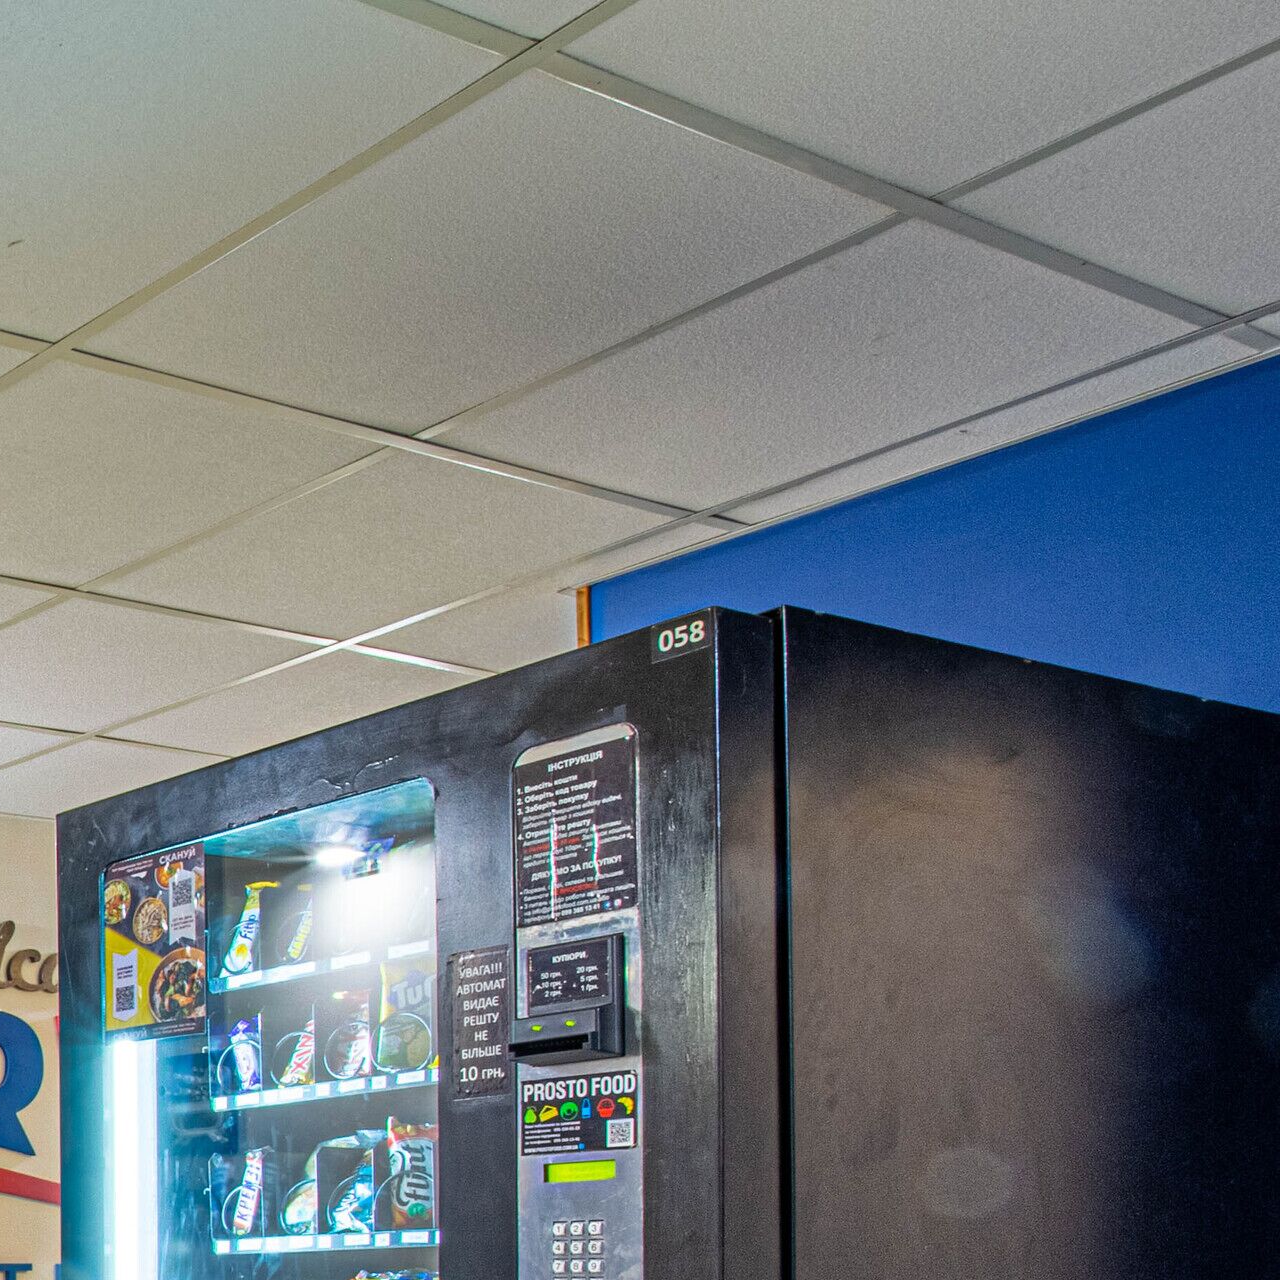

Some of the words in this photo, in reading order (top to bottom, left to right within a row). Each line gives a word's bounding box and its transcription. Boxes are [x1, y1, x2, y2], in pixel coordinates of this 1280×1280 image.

[658, 620, 705, 652] 058
[547, 750, 603, 772] ІНСТРУКЦІЯ
[159, 846, 196, 864] СКАНУЙ
[531, 867, 569, 882] ДЯКУМО
[459, 962, 503, 979] УВАГА!!!
[456, 978, 506, 997] АВТОМАТ
[463, 996, 499, 1011] ВИДАЄ
[463, 1012, 500, 1027] РЕШТУ
[474, 1030, 488, 1042] НЕ
[461, 1044, 502, 1060] БІЛЬШЕ
[460, 1066, 478, 1082] 10
[523, 1078, 588, 1102] PROSTO
[591, 1074, 635, 1096] FOOD
